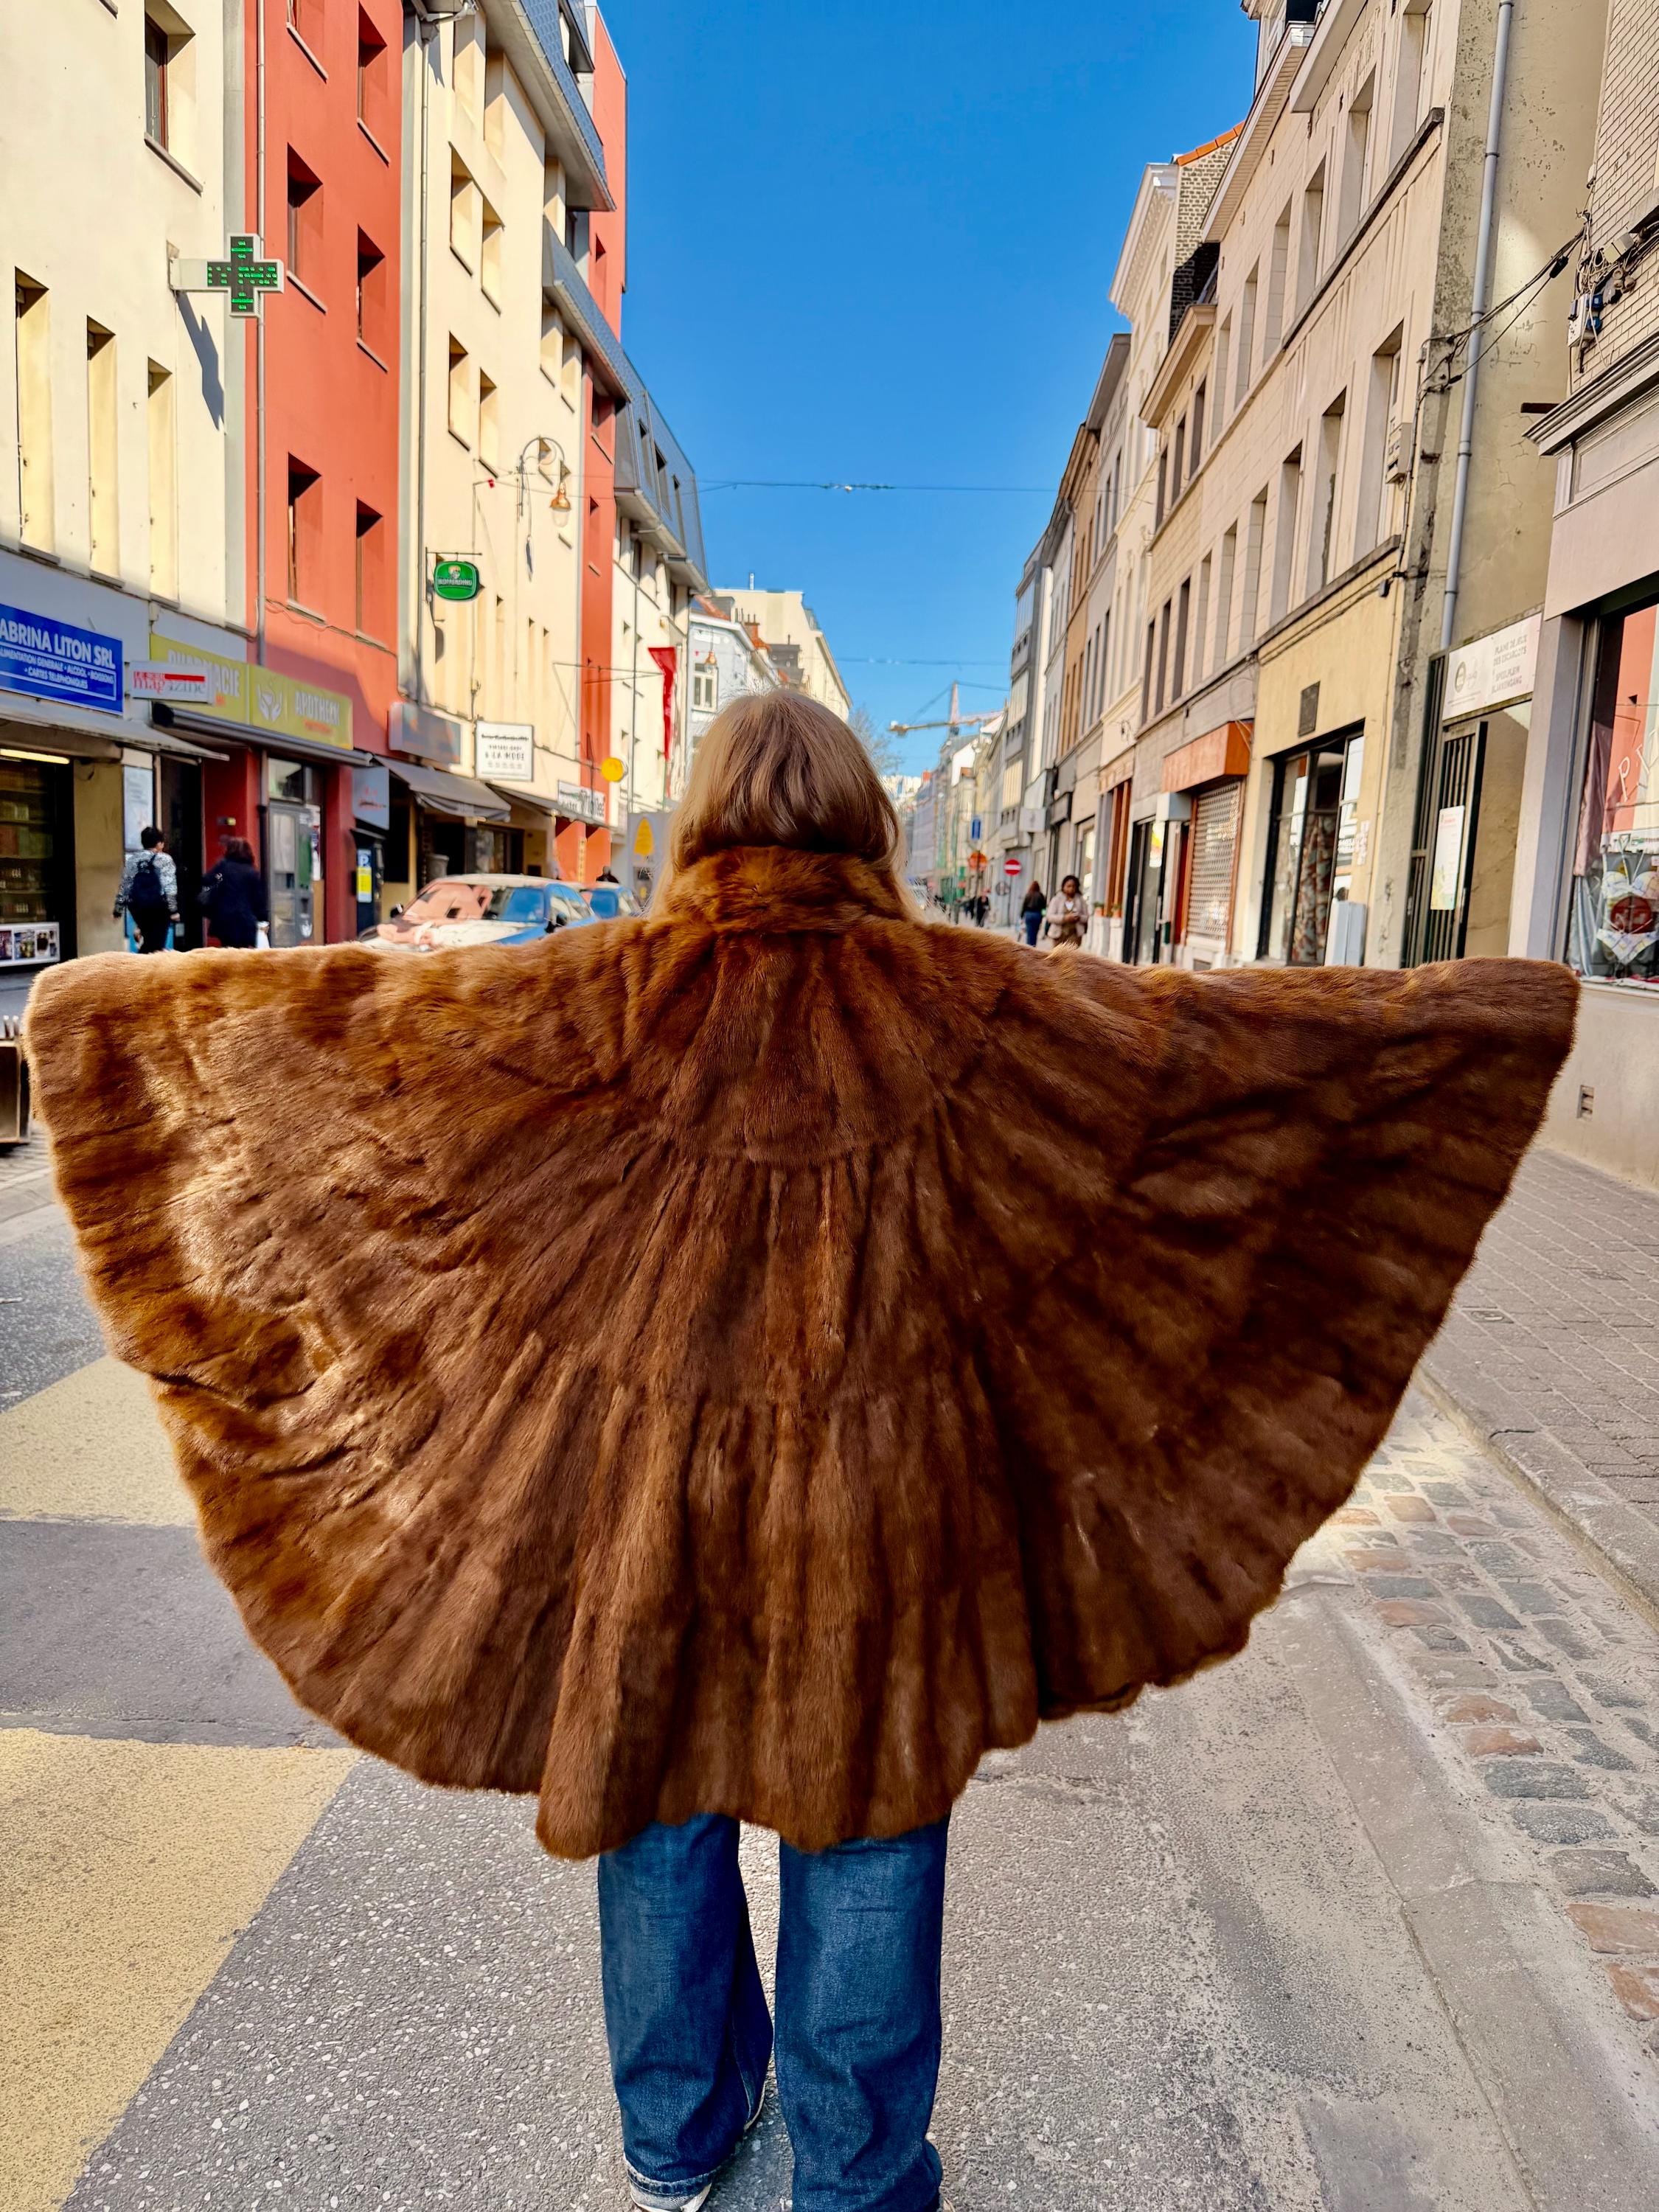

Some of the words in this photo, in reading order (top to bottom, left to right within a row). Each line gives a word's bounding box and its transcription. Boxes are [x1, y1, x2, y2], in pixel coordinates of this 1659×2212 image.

[55, 633, 91, 663] LITON
[94, 645, 116, 669] SRL
[133, 678, 207, 695] magazine
